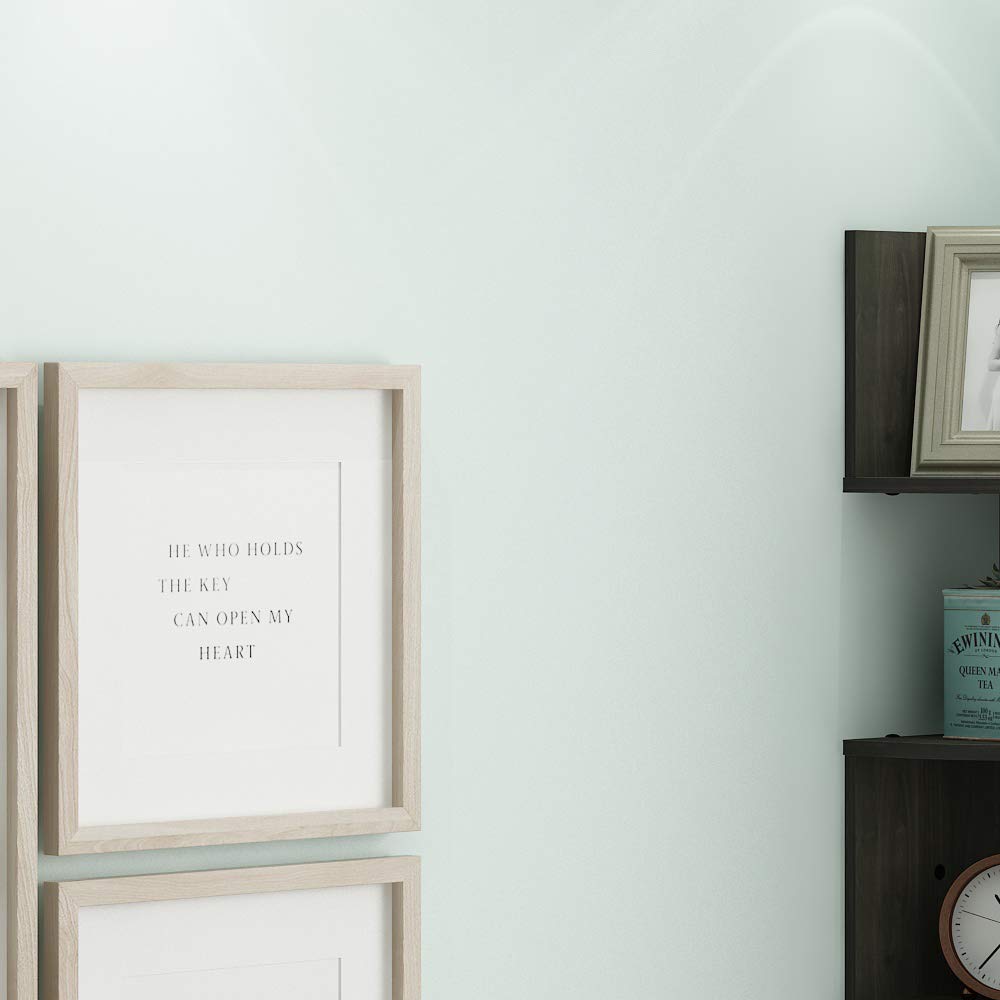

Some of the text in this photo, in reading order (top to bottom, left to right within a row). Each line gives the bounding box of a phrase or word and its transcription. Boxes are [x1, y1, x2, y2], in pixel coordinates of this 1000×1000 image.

[168, 541, 303, 558] HE WHO HOLDS
[158, 576, 231, 593] THE KEY
[173, 608, 294, 627] CAN OPEN MY
[199, 644, 256, 660] HEART
[959, 665, 987, 677] QUEEN
[977, 679, 993, 689] TEA
